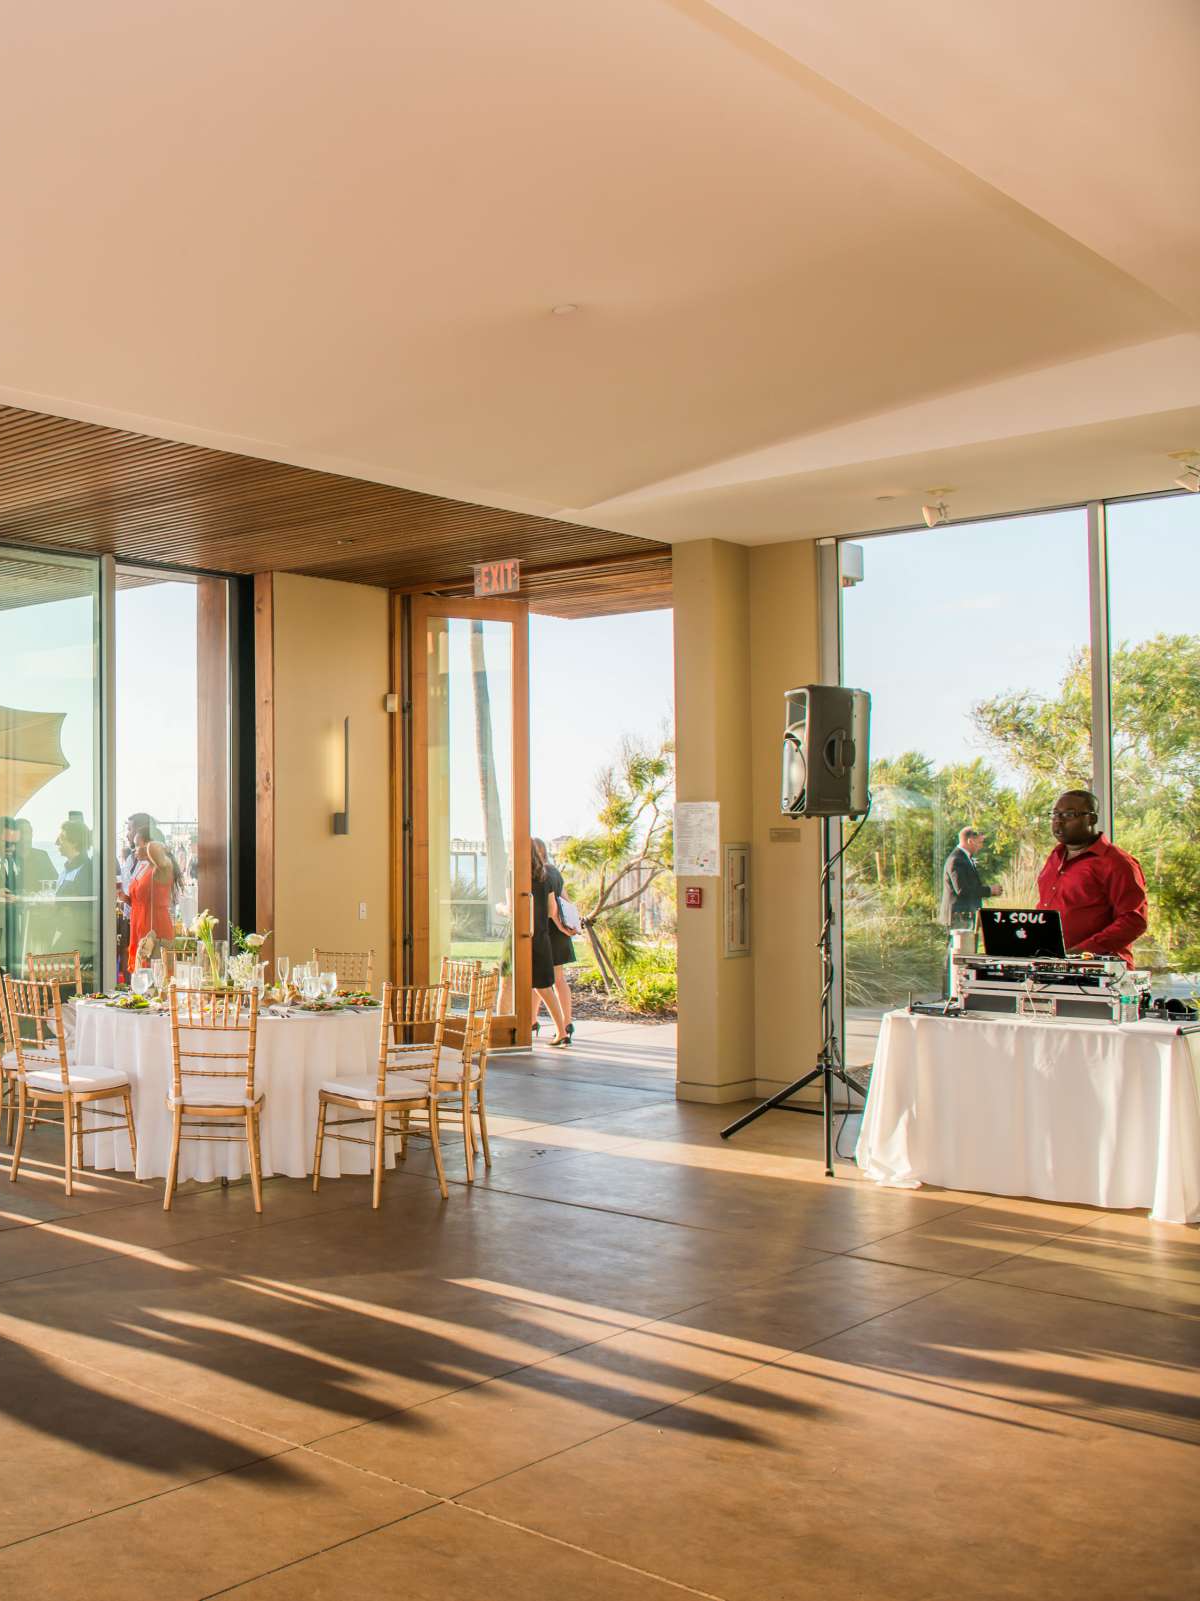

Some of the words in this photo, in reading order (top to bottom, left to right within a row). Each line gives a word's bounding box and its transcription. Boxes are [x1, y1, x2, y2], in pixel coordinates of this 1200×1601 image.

[481, 561, 513, 593] EXIT
[993, 911, 1006, 924] J.
[1009, 912, 1047, 924] SOUL
